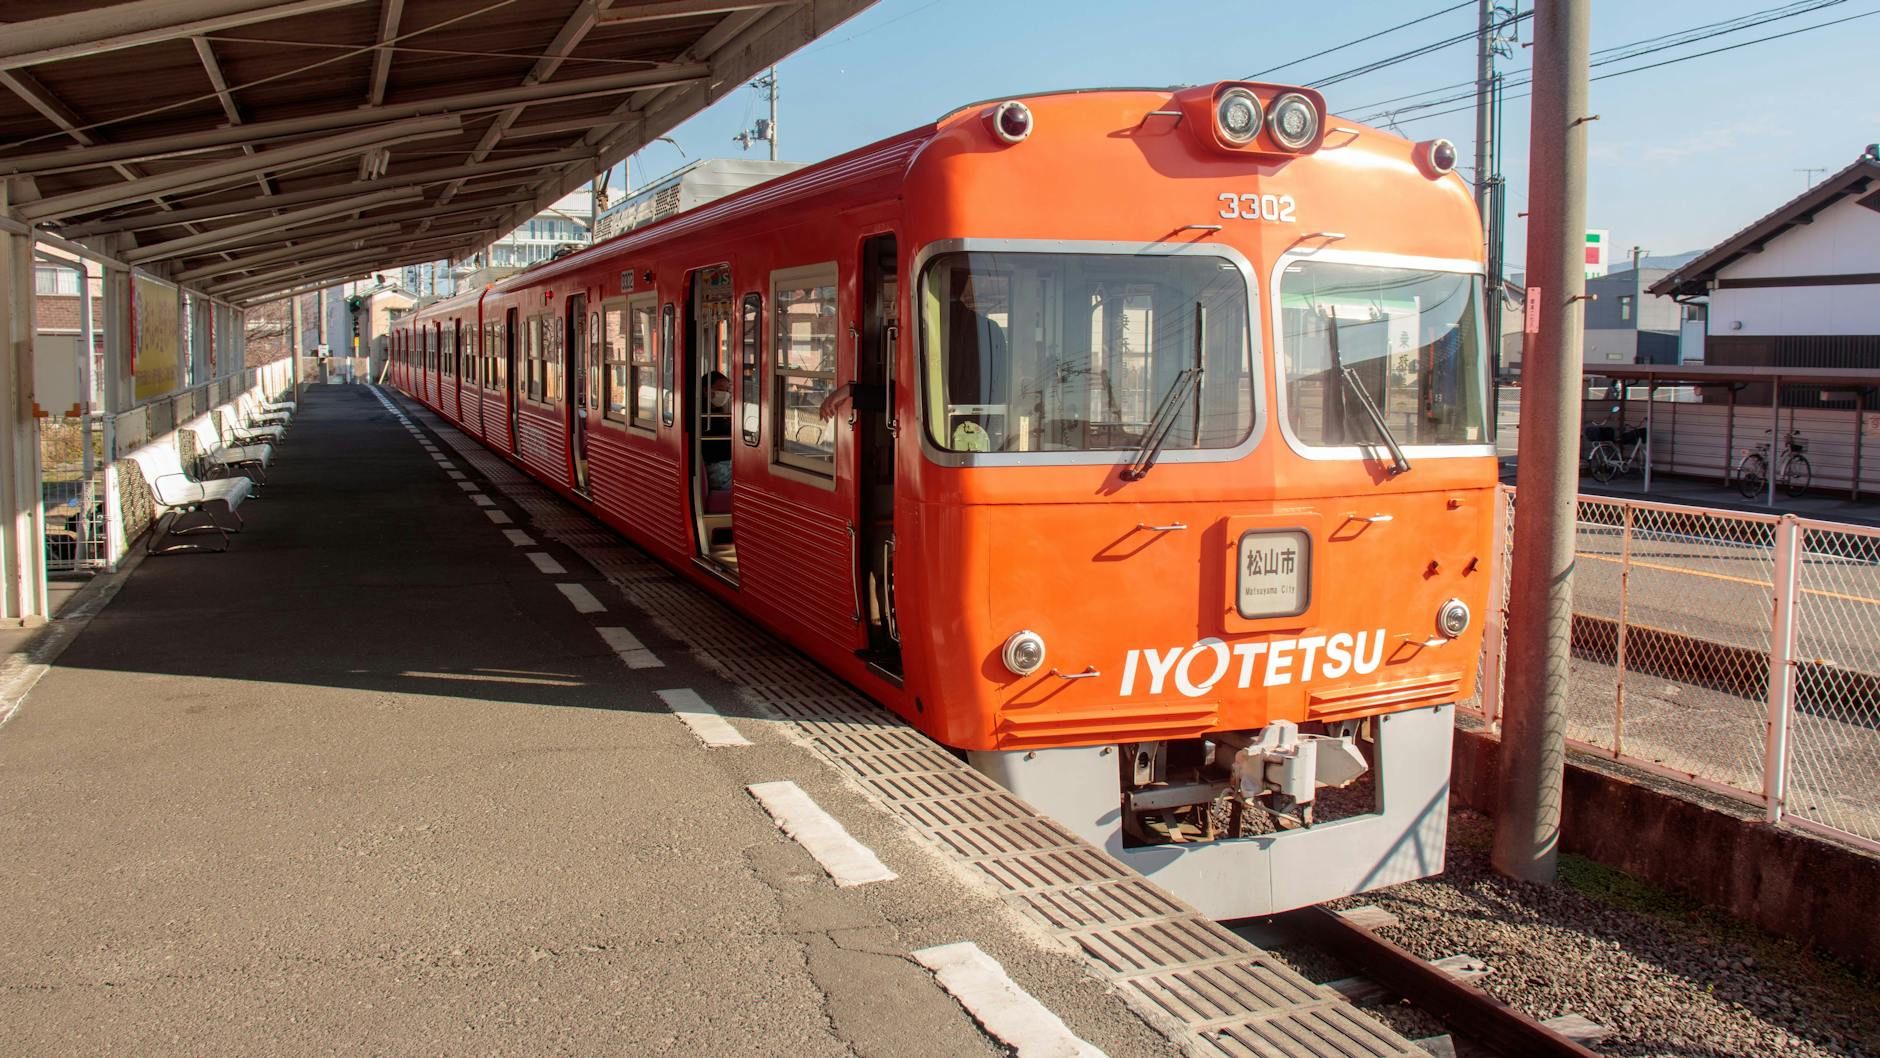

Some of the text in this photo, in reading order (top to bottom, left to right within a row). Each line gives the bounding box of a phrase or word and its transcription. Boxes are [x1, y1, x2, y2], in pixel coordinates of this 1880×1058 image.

[1219, 192, 1297, 222] 3302
[1246, 547, 1296, 577] 松山市
[1245, 584, 1295, 596] Matsuyama City
[1119, 628, 1387, 697] IYOTETSU
